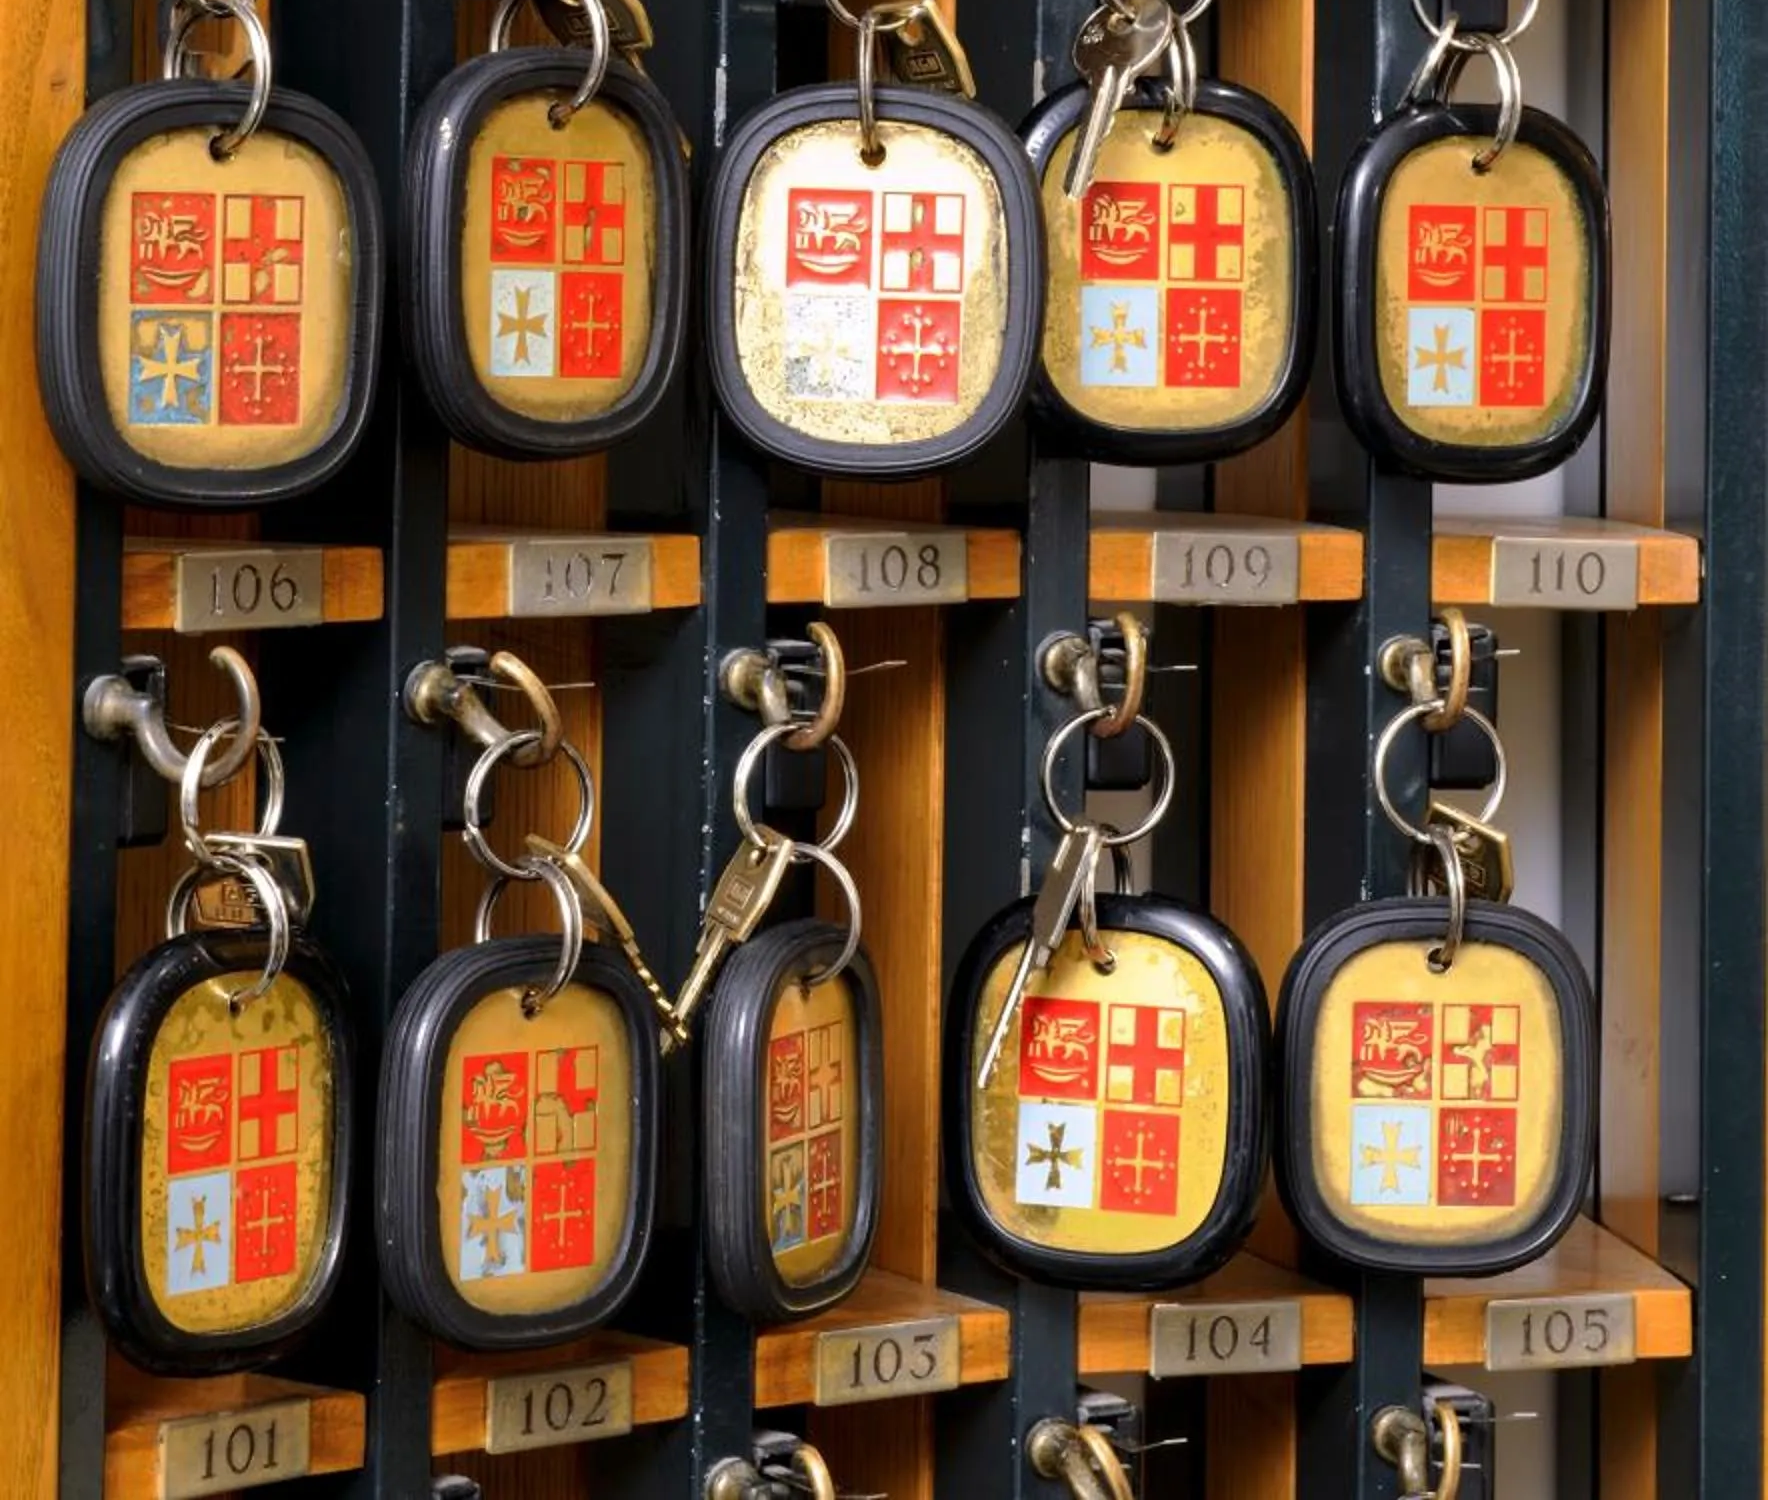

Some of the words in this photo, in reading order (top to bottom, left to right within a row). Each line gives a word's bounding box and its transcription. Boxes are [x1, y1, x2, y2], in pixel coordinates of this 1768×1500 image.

[208, 562, 297, 615] 106
[542, 554, 623, 599] 107
[857, 545, 941, 590] 108
[1181, 545, 1272, 588] 109
[1529, 552, 1605, 594] 110
[1184, 1316, 1271, 1360] 104
[1520, 1309, 1610, 1355] 105
[849, 1334, 937, 1388] 103
[521, 1378, 608, 1435] 102
[201, 1421, 280, 1480] 101
